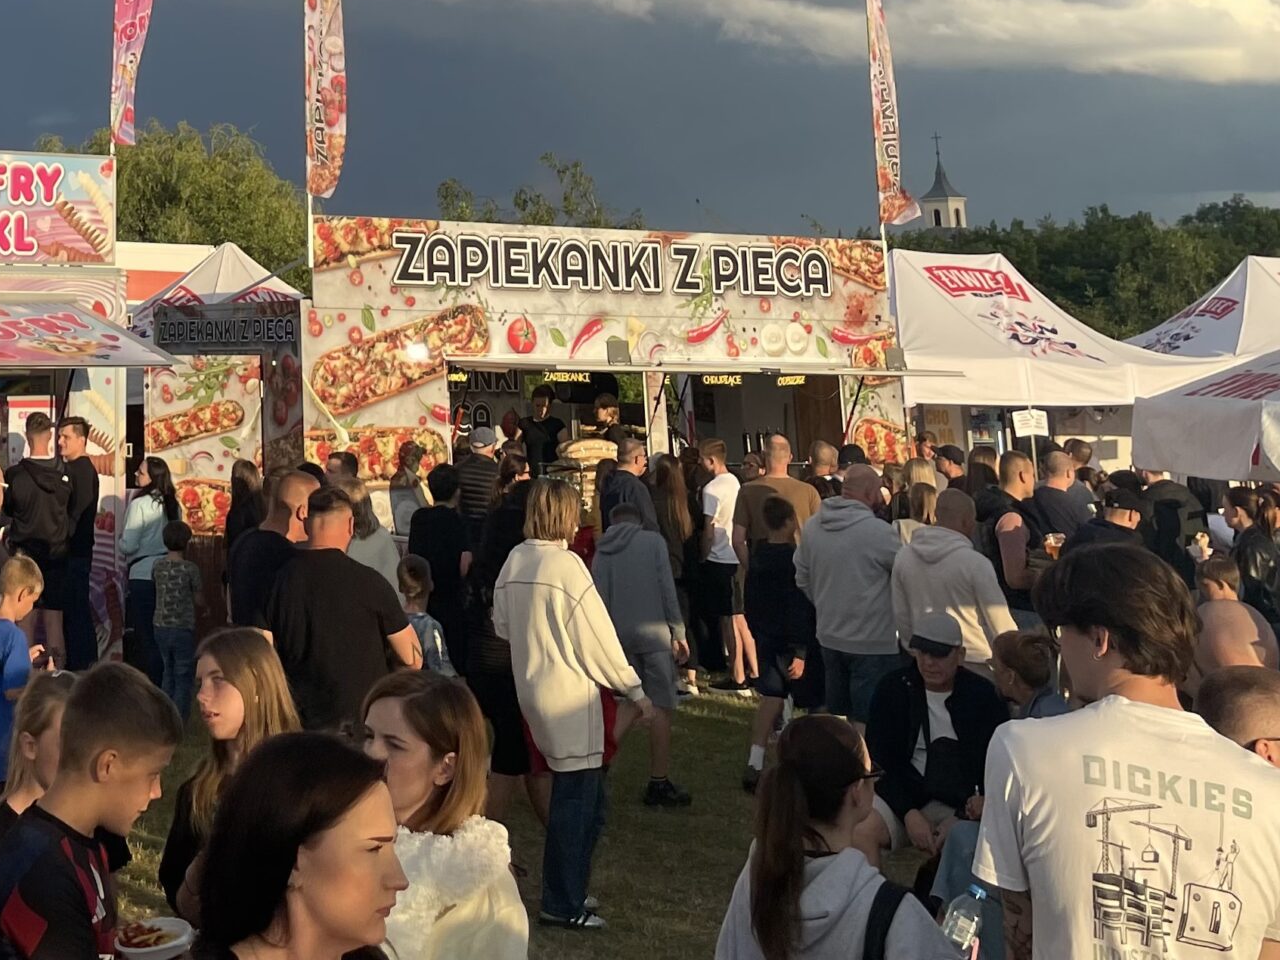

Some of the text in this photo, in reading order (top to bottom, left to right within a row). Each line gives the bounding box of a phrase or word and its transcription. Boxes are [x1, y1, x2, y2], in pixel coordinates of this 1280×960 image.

[392, 231, 833, 298] ZAPIEKANKI Z PIECA
[160, 318, 295, 343] ZAPIEKANKI Z PIECA
[1082, 754, 1253, 820] DICKIES
